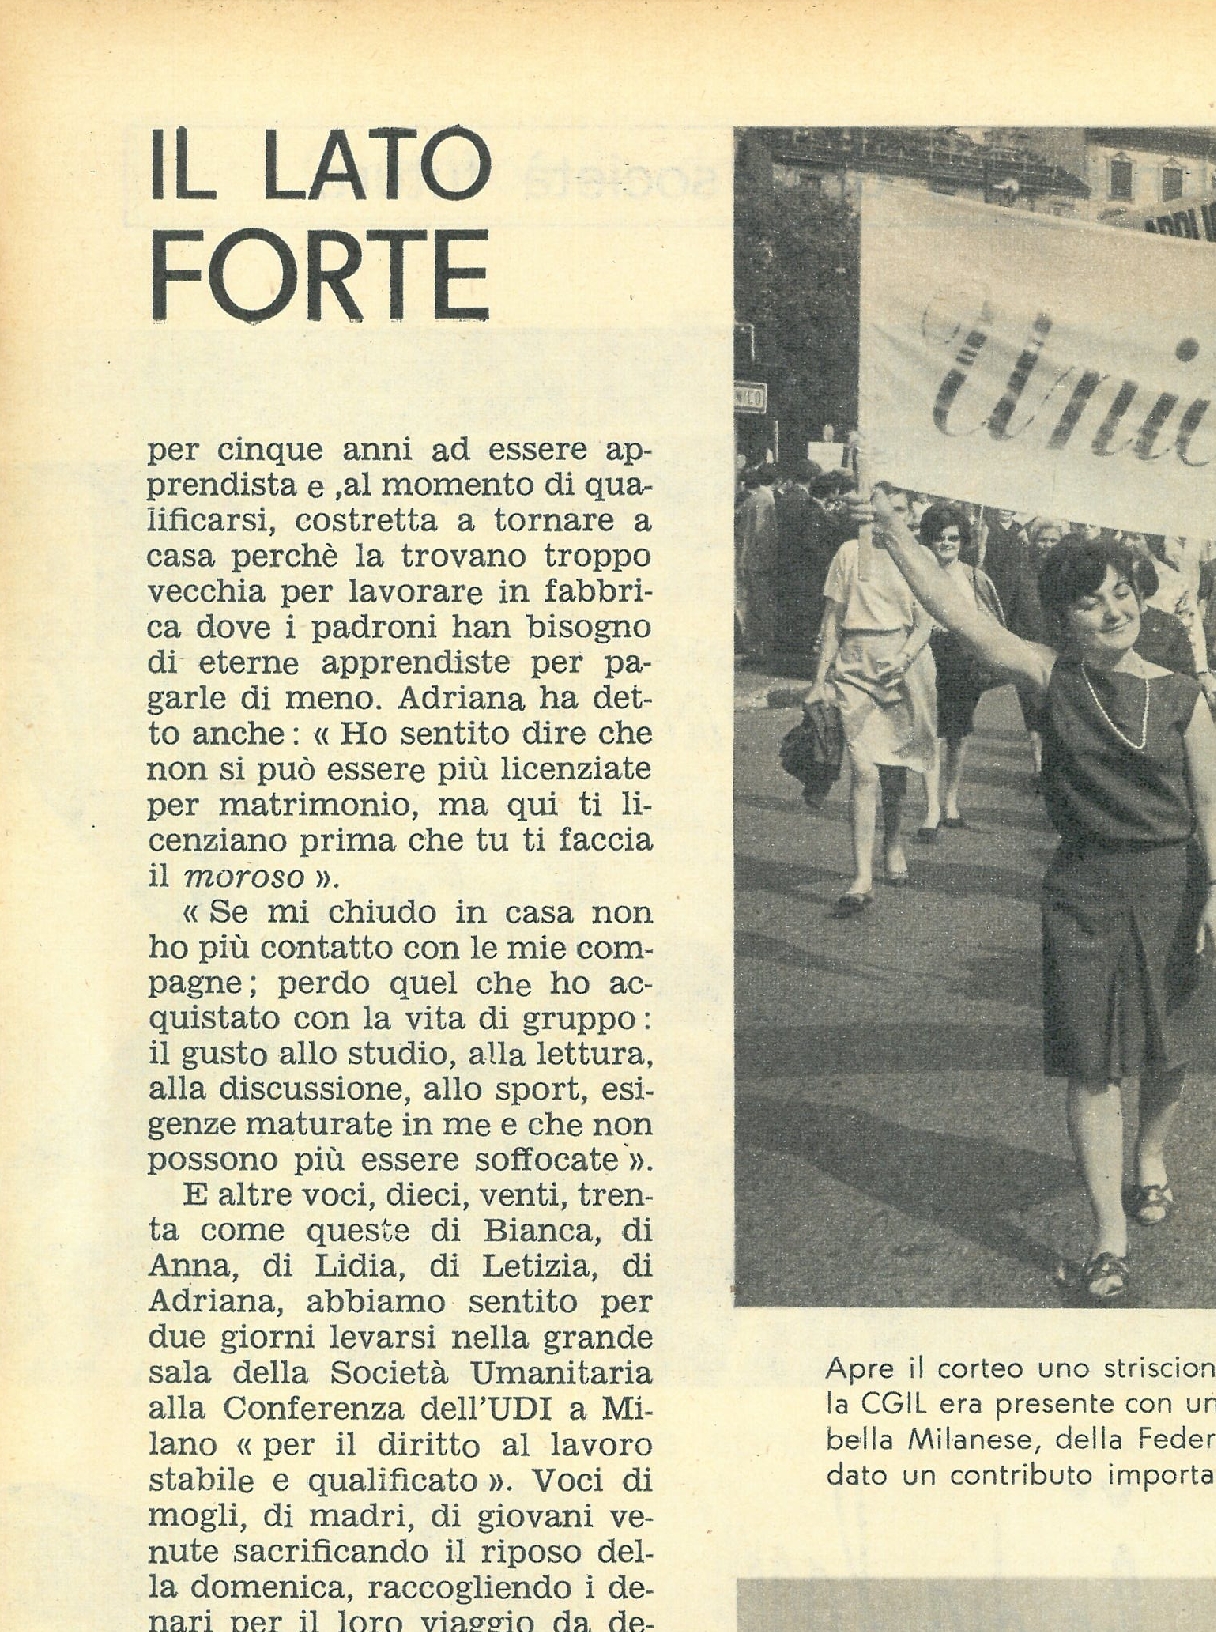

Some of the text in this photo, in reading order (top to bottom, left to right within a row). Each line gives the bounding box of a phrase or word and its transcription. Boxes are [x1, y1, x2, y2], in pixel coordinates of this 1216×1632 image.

[153, 124, 492, 201] IL LATO
[153, 228, 489, 324] FORTE
[148, 436, 651, 466] per cinque anni ad essere ap-
[147, 543, 650, 572] casa perchè la trovano troppo
[148, 1253, 653, 1282] Anna, di Lidia, di Letizia, di
[149, 1360, 653, 1384] sala della Società Umanitaria
[825, 1357, 893, 1384] Apre
[910, 1355, 922, 1378] il
[939, 1359, 1023, 1379] corteo
[1039, 1363, 1089, 1378] uno
[828, 1391, 847, 1414] la
[862, 1391, 926, 1414] CGIL
[940, 1398, 981, 1413] era
[997, 1394, 1114, 1418] presente
[1126, 1398, 1171, 1413] con
